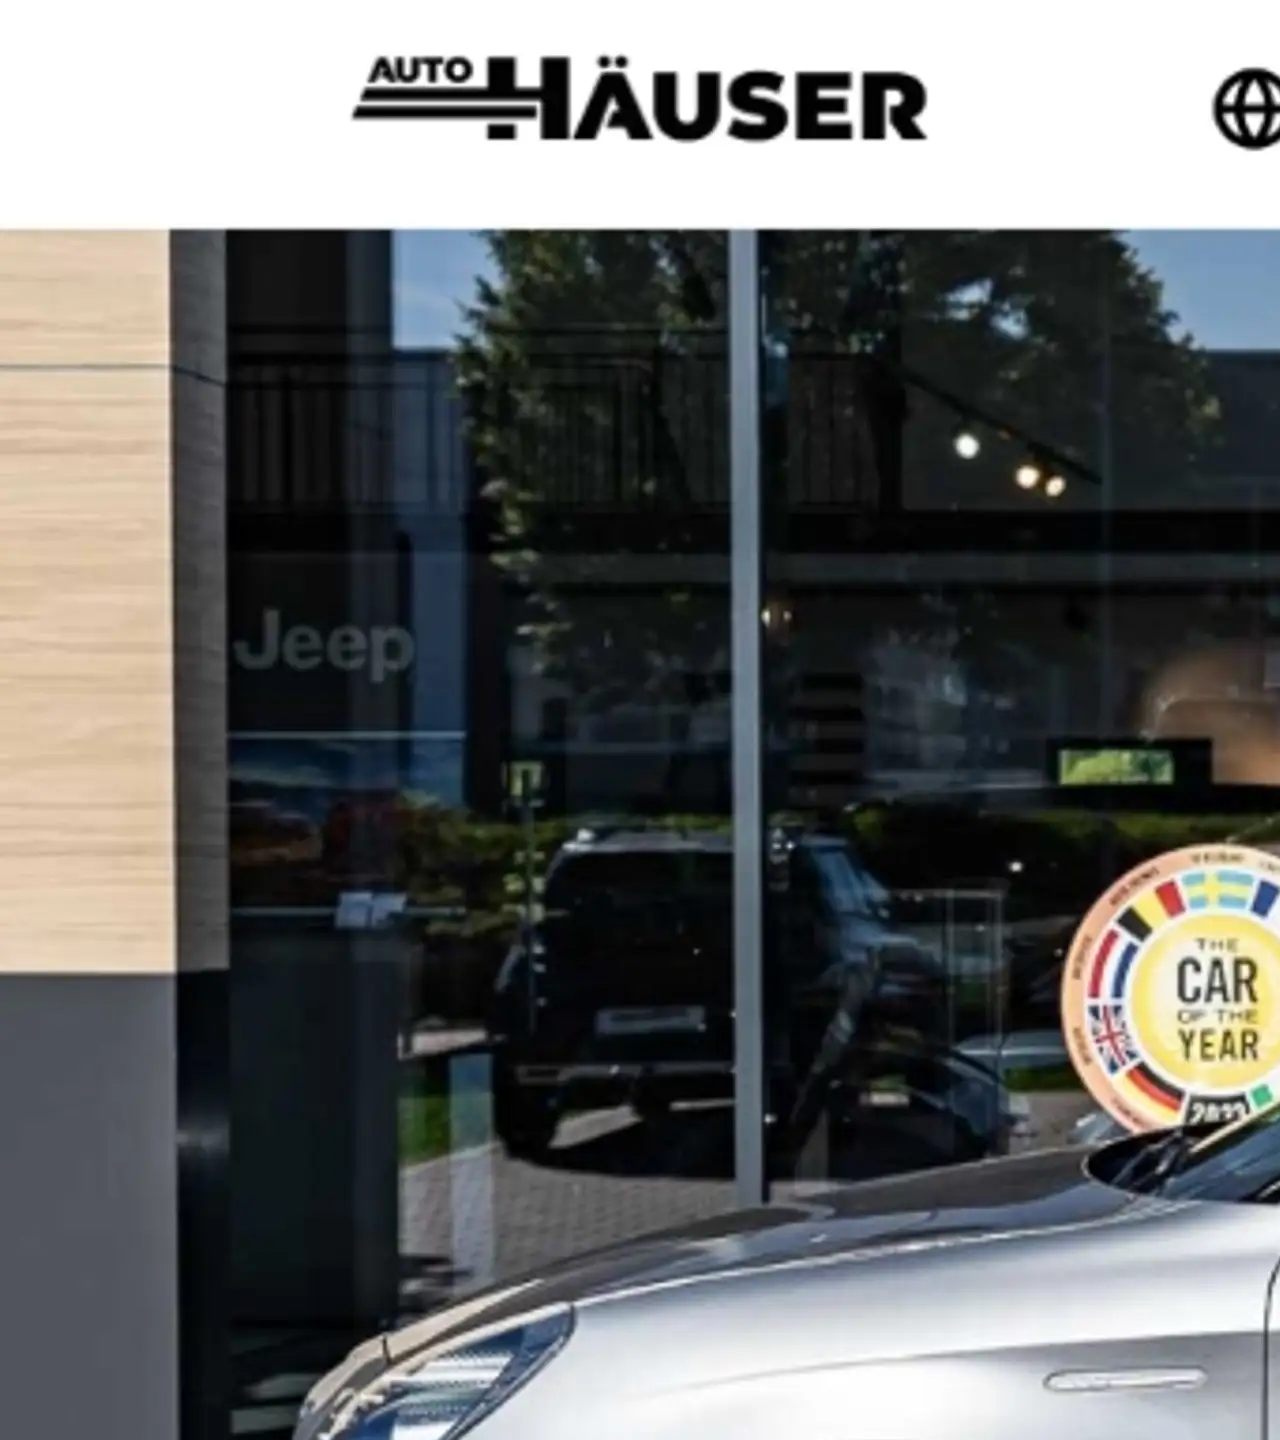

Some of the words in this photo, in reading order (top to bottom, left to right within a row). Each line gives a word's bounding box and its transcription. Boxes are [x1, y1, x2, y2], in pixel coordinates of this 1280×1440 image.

[232, 608, 415, 684] Jeep
[1195, 937, 1240, 951] THE
[1177, 956, 1259, 1004] CAR
[1177, 1008, 1207, 1024] OF
[1214, 1008, 1259, 1024] THE
[1177, 1028, 1259, 1062] YEAR
